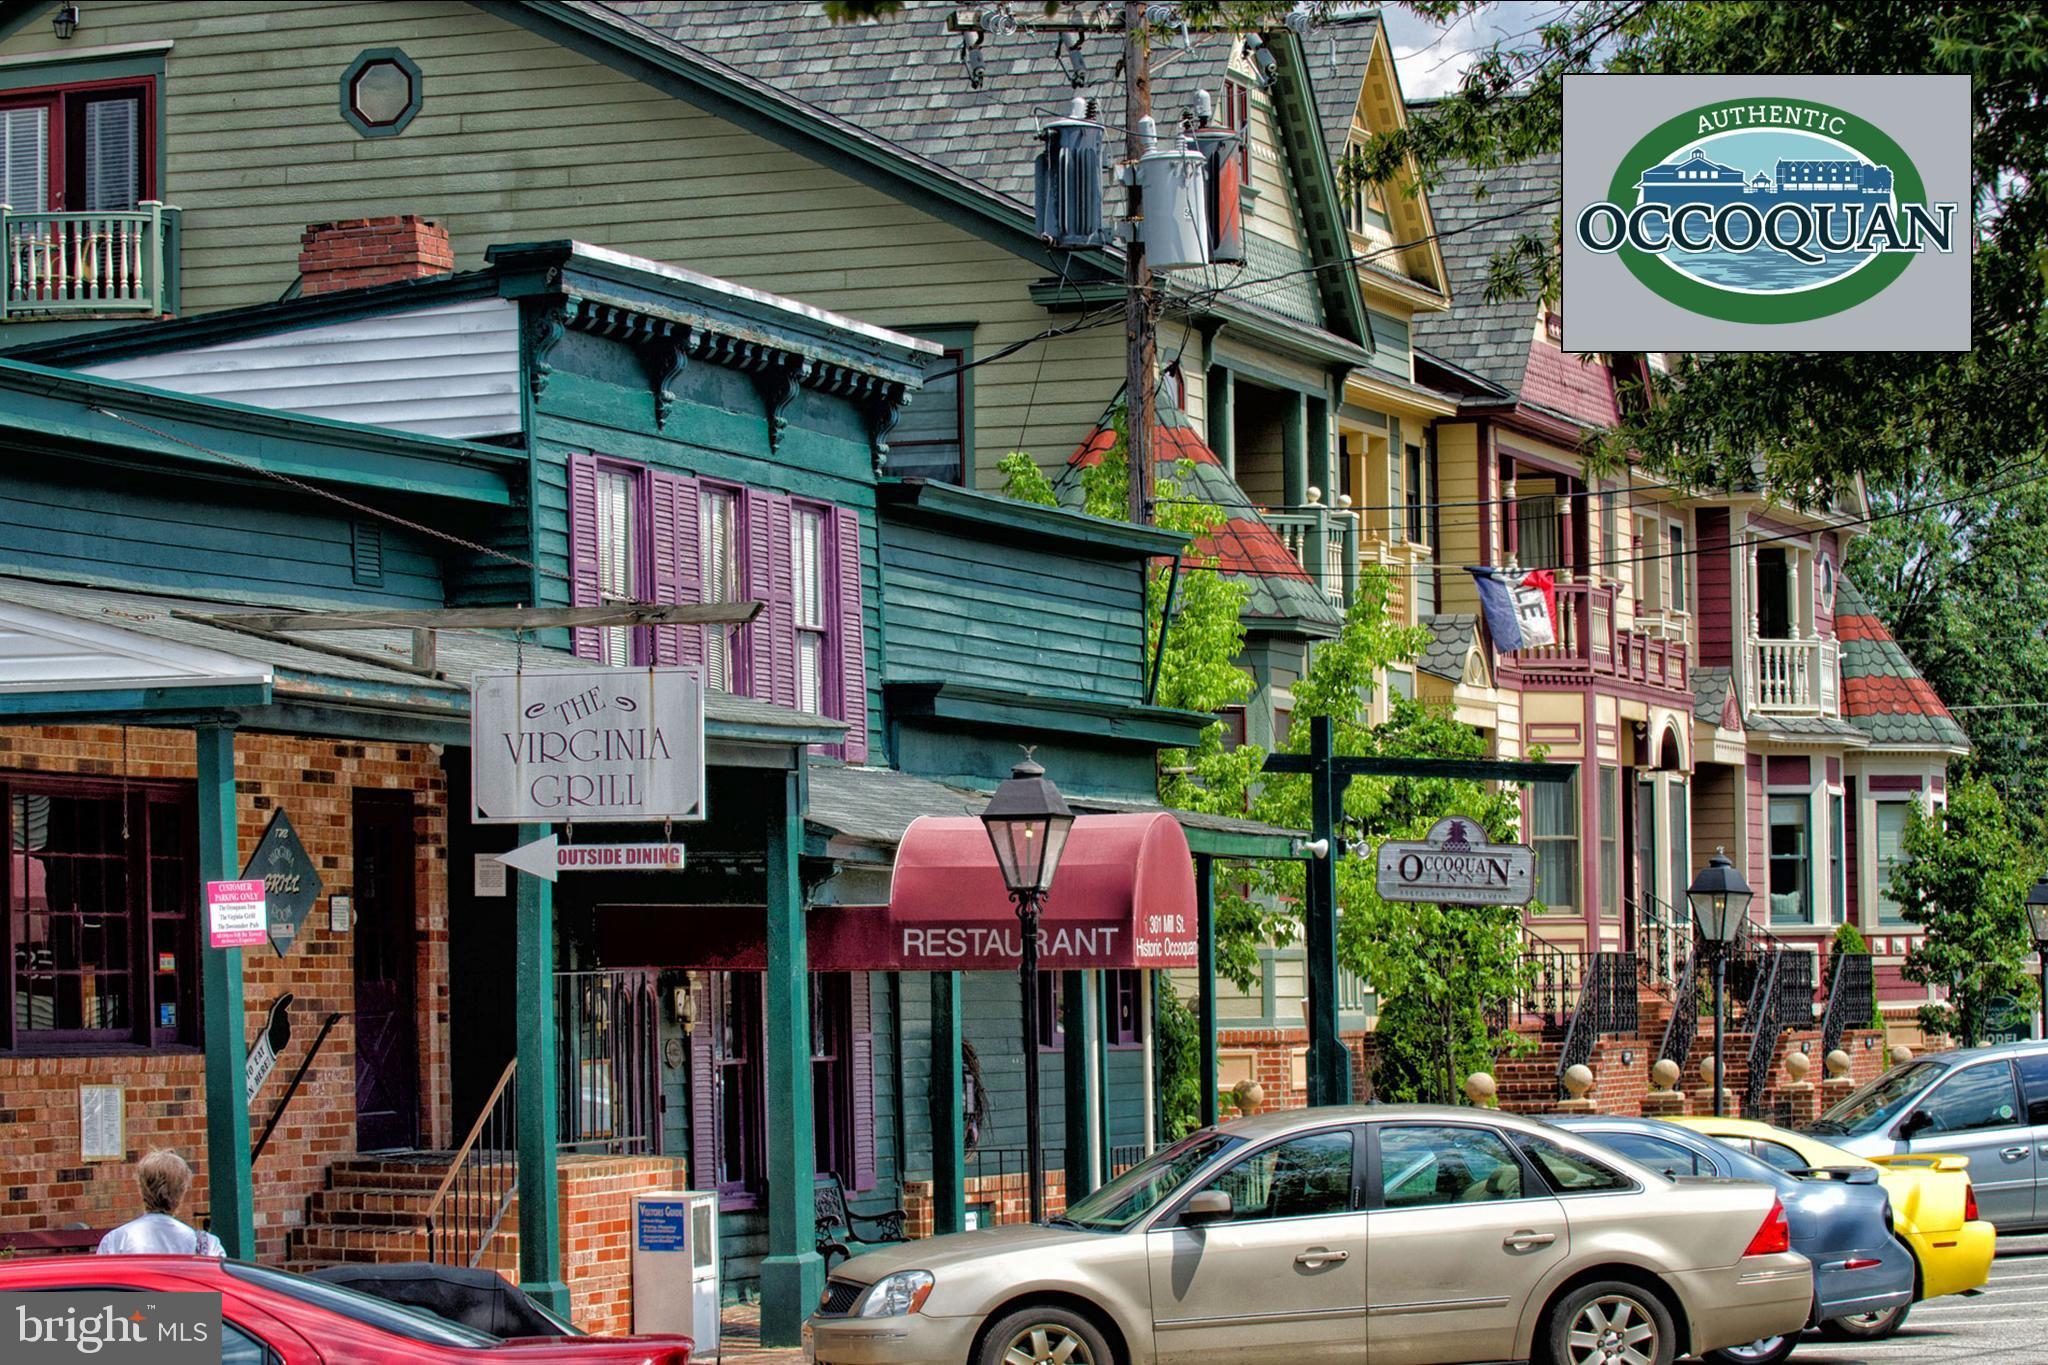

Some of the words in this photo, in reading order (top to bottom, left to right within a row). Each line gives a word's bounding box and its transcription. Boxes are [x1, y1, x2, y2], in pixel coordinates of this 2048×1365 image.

[554, 685, 606, 726] THE
[502, 728, 672, 765] VIRGINIA
[530, 774, 643, 808] GRILL
[557, 848, 622, 866] OUTSIDE
[626, 847, 680, 865] DINING
[1399, 853, 1512, 886] OCCOQUAN
[1435, 874, 1473, 883] INN
[265, 873, 300, 893] GRILL
[240, 892, 258, 900] ONLY
[1149, 914, 1162, 933] 301
[1163, 914, 1175, 932] Mill
[1176, 914, 1186, 932] St.
[1136, 940, 1162, 957] Historic
[1164, 938, 1197, 960] Occoquan
